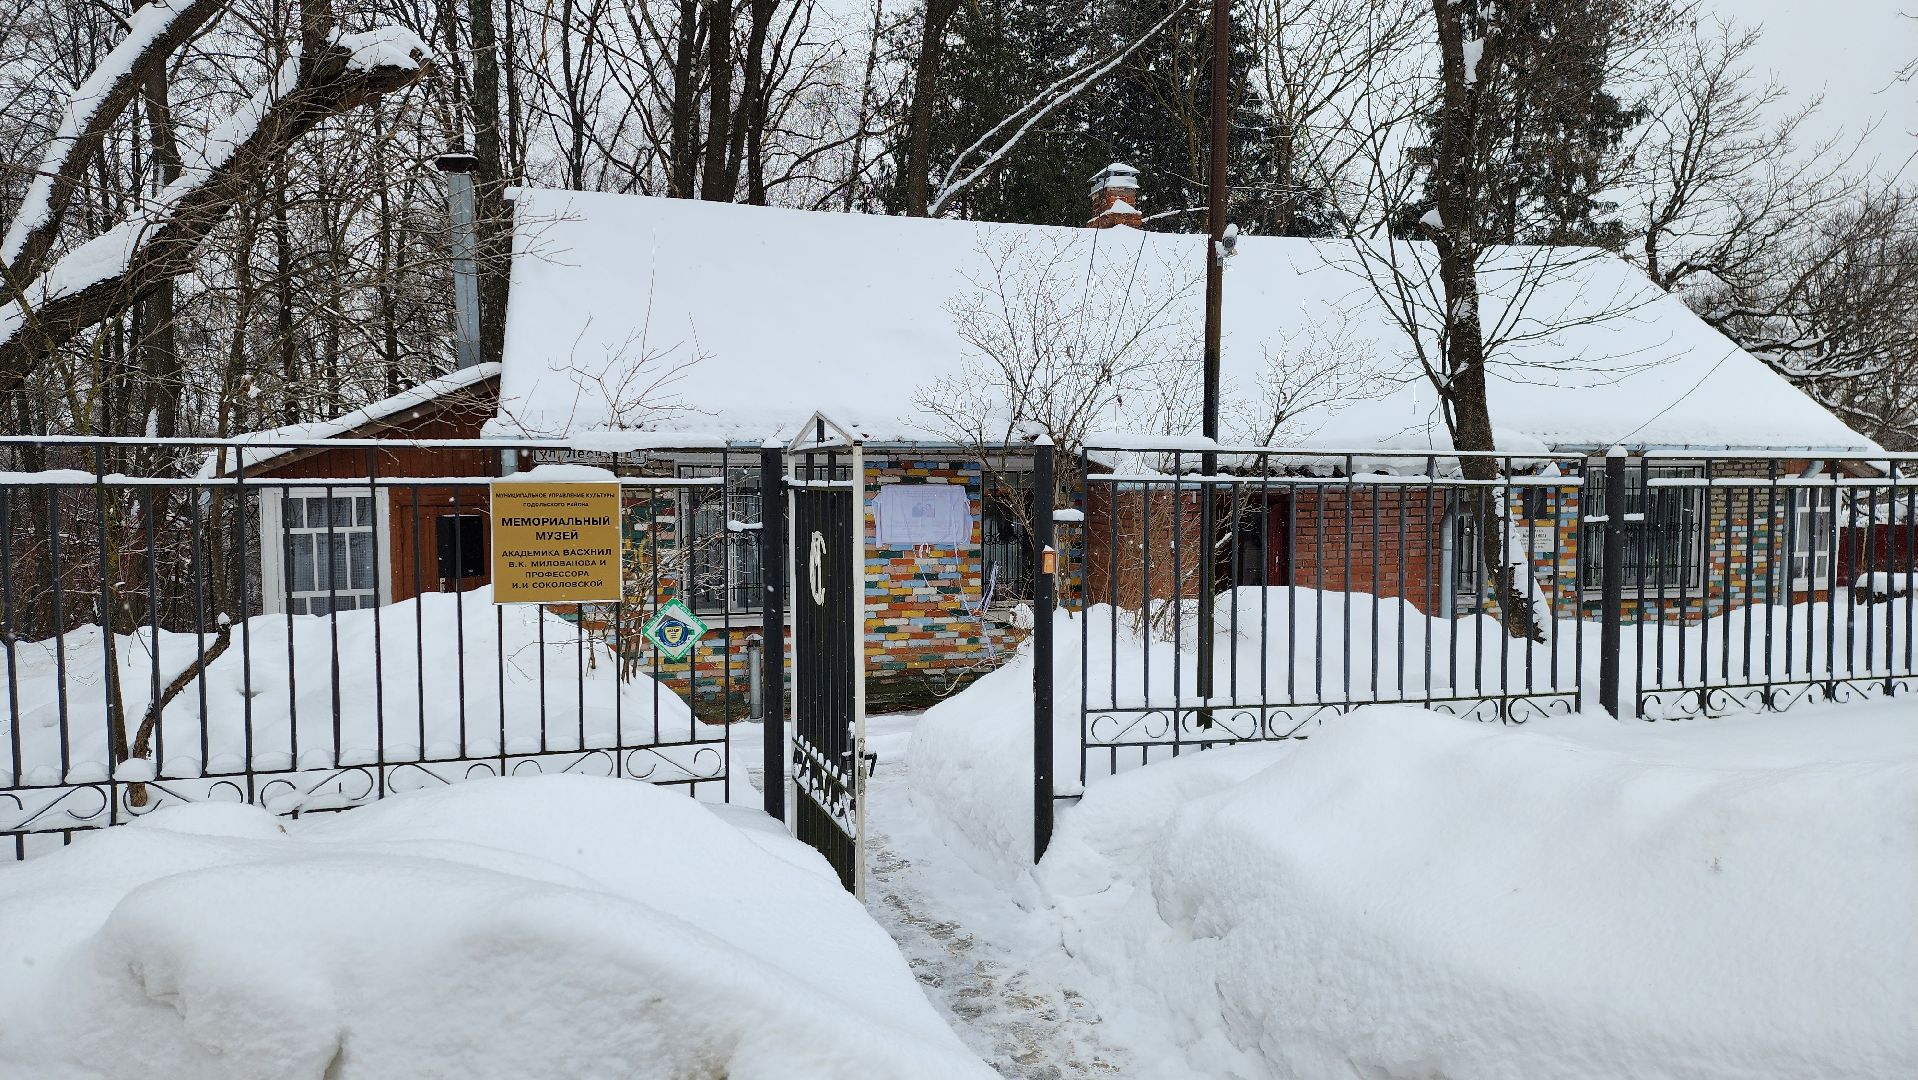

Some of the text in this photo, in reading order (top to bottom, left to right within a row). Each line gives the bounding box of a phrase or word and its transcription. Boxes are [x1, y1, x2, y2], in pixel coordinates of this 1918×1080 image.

[501, 516, 611, 526] МЕМОРИАЛЬНЫЙ
[535, 529, 578, 540] МУЗЕЙ
[501, 548, 612, 558] АКАДЕМИКА ВАСХНИЛ
[508, 560, 527, 568] В.К.
[530, 559, 597, 568] МИЛОВАНОВА
[525, 571, 590, 579] ПРОФЕССОРА
[532, 579, 603, 589] СОКОЛОВСКОЙ
